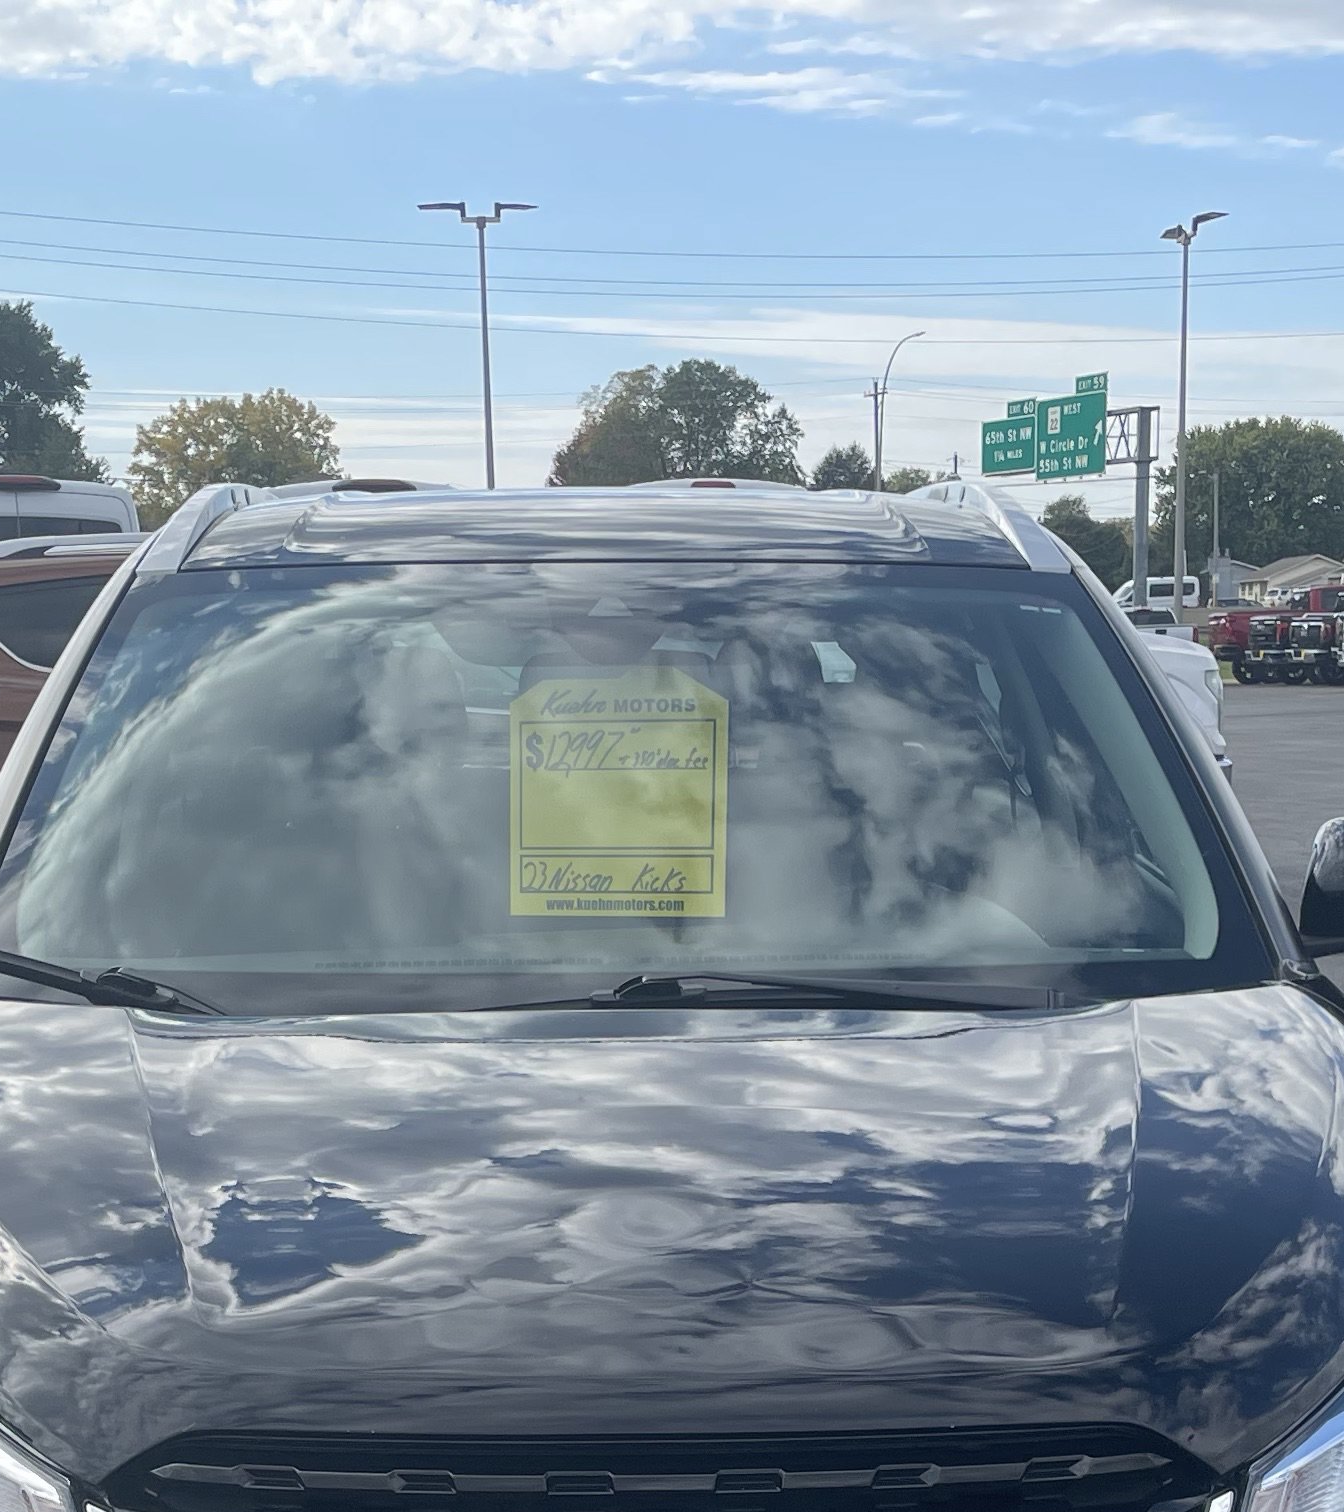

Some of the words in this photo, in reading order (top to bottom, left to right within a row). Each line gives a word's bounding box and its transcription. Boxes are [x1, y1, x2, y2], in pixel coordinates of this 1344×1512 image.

[1078, 380, 1091, 390] EXIT
[1094, 376, 1104, 389] 59
[1023, 401, 1034, 414] 60
[1063, 403, 1081, 415] WEST
[1050, 418, 1058, 430] 22
[985, 431, 1005, 444] 65th
[1008, 429, 1016, 442] St
[1020, 427, 1032, 440] NW
[1040, 441, 1047, 454] W
[1050, 438, 1074, 453] Circle
[1078, 435, 1088, 450] Dr
[1007, 449, 1023, 459] MILES
[1039, 459, 1059, 473] 55th
[1063, 457, 1072, 470] St
[1076, 455, 1088, 468] NW
[540, 690, 606, 718] Kuehn
[614, 698, 696, 713] MOTORS
[686, 747, 709, 769] fee
[548, 862, 613, 891] Nissan
[546, 898, 685, 912] www.kuehnmotors.com
